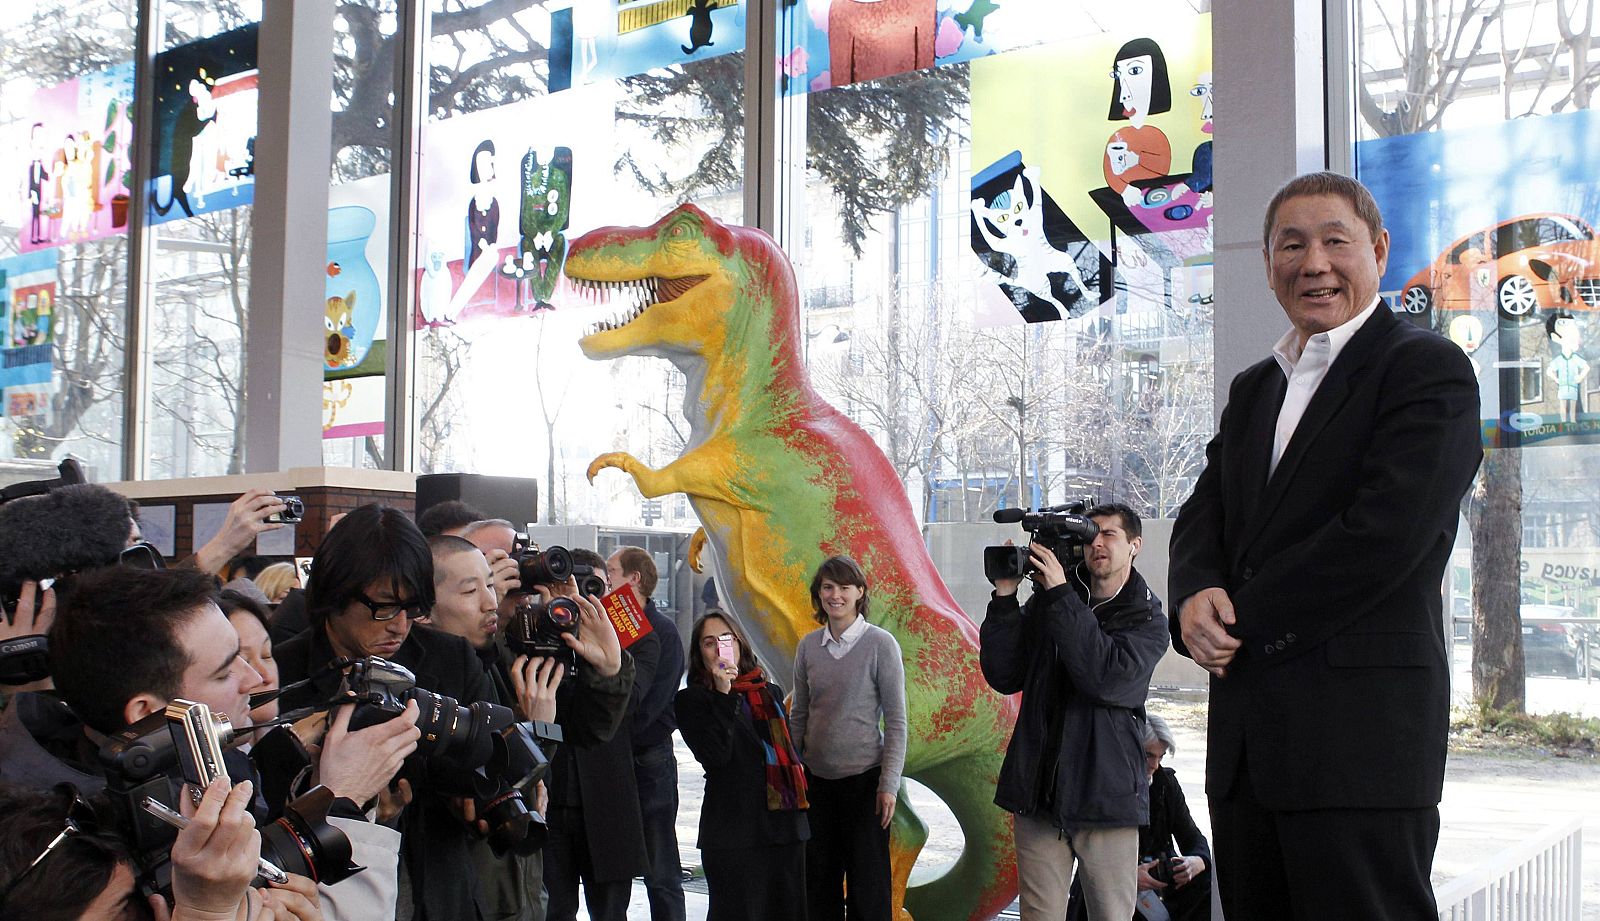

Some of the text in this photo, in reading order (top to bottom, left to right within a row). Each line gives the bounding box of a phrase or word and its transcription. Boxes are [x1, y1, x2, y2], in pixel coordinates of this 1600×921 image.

[607, 605, 626, 633] KITANO
[610, 593, 622, 610] BEAT
[618, 608, 639, 639] TAKESHI
[2, 640, 38, 653] Canon
